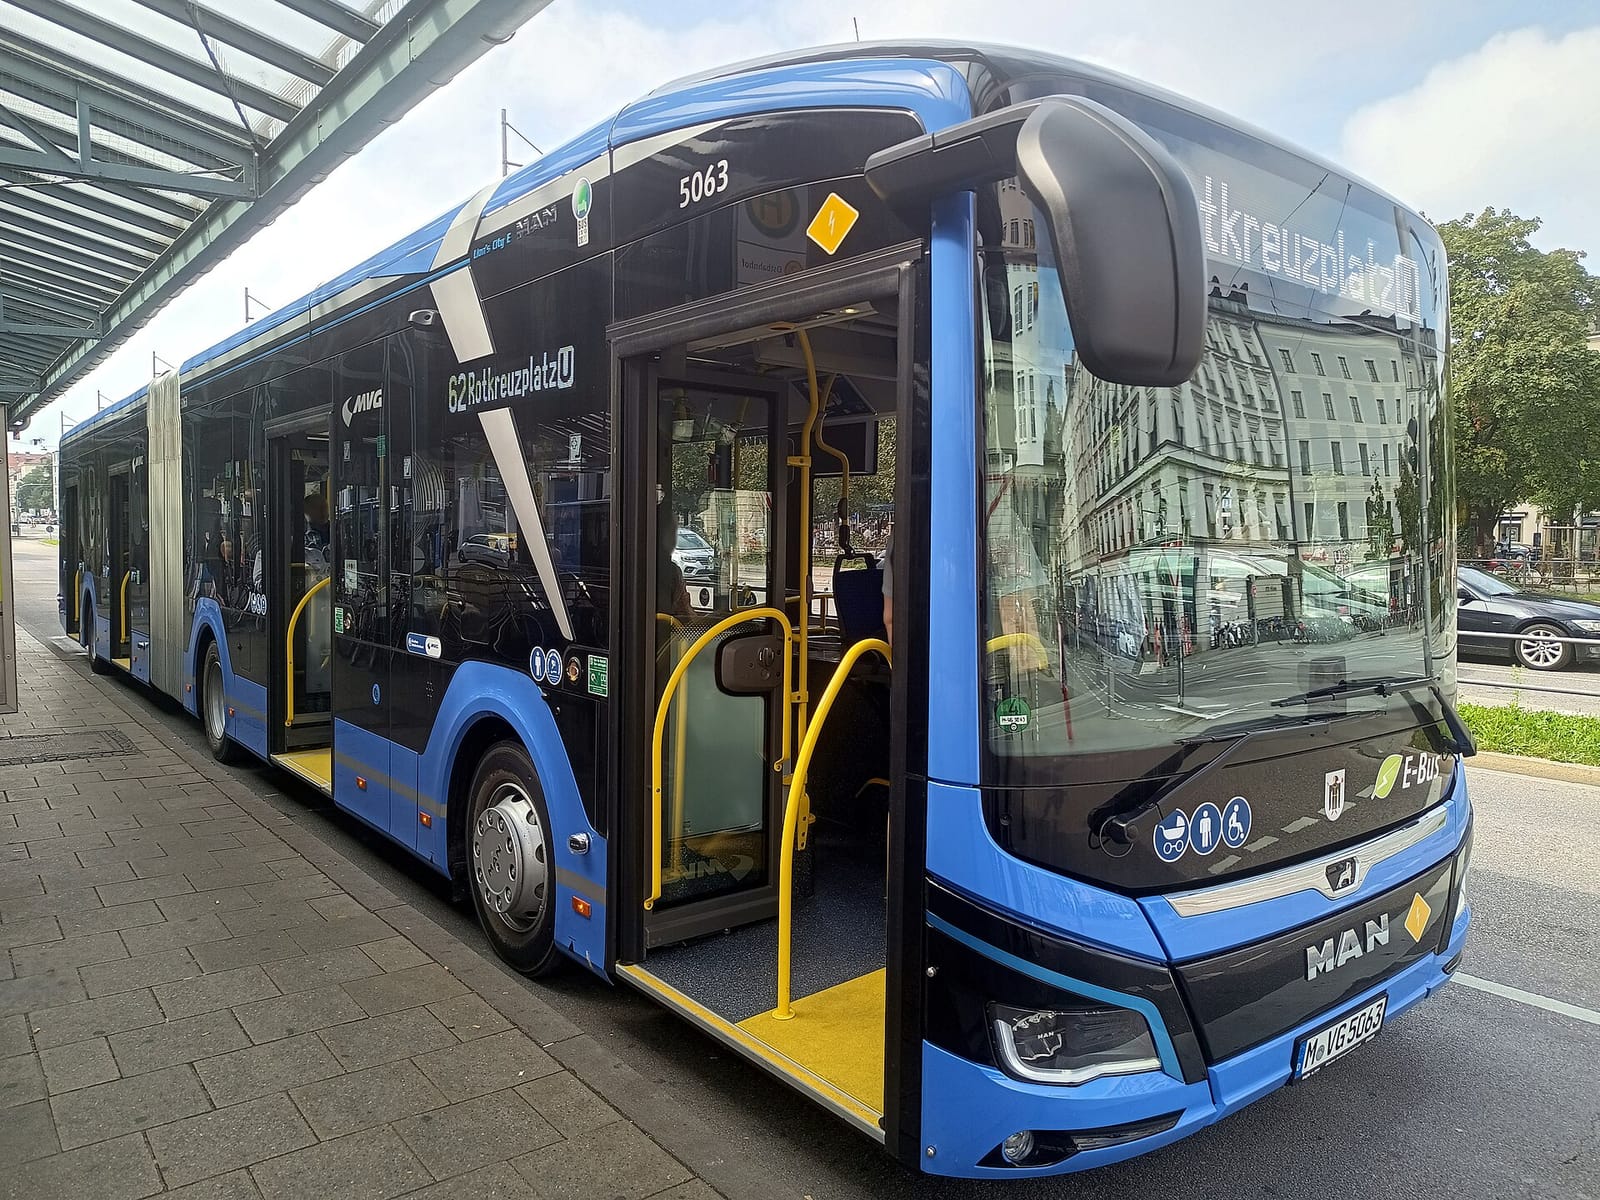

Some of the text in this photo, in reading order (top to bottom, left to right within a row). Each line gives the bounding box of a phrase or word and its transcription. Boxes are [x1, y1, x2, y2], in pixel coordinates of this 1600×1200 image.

[679, 159, 729, 208] 5063
[506, 232, 512, 243] E
[515, 204, 558, 240] MAN
[448, 372, 467, 414] 62
[468, 351, 557, 405] Rotkreuzplatz
[352, 388, 382, 414] MVG
[1402, 752, 1440, 789] E-Bus
[1306, 913, 1389, 981] MAN
[1037, 1031, 1054, 1040] MAN
[1304, 1038, 1319, 1069] M
